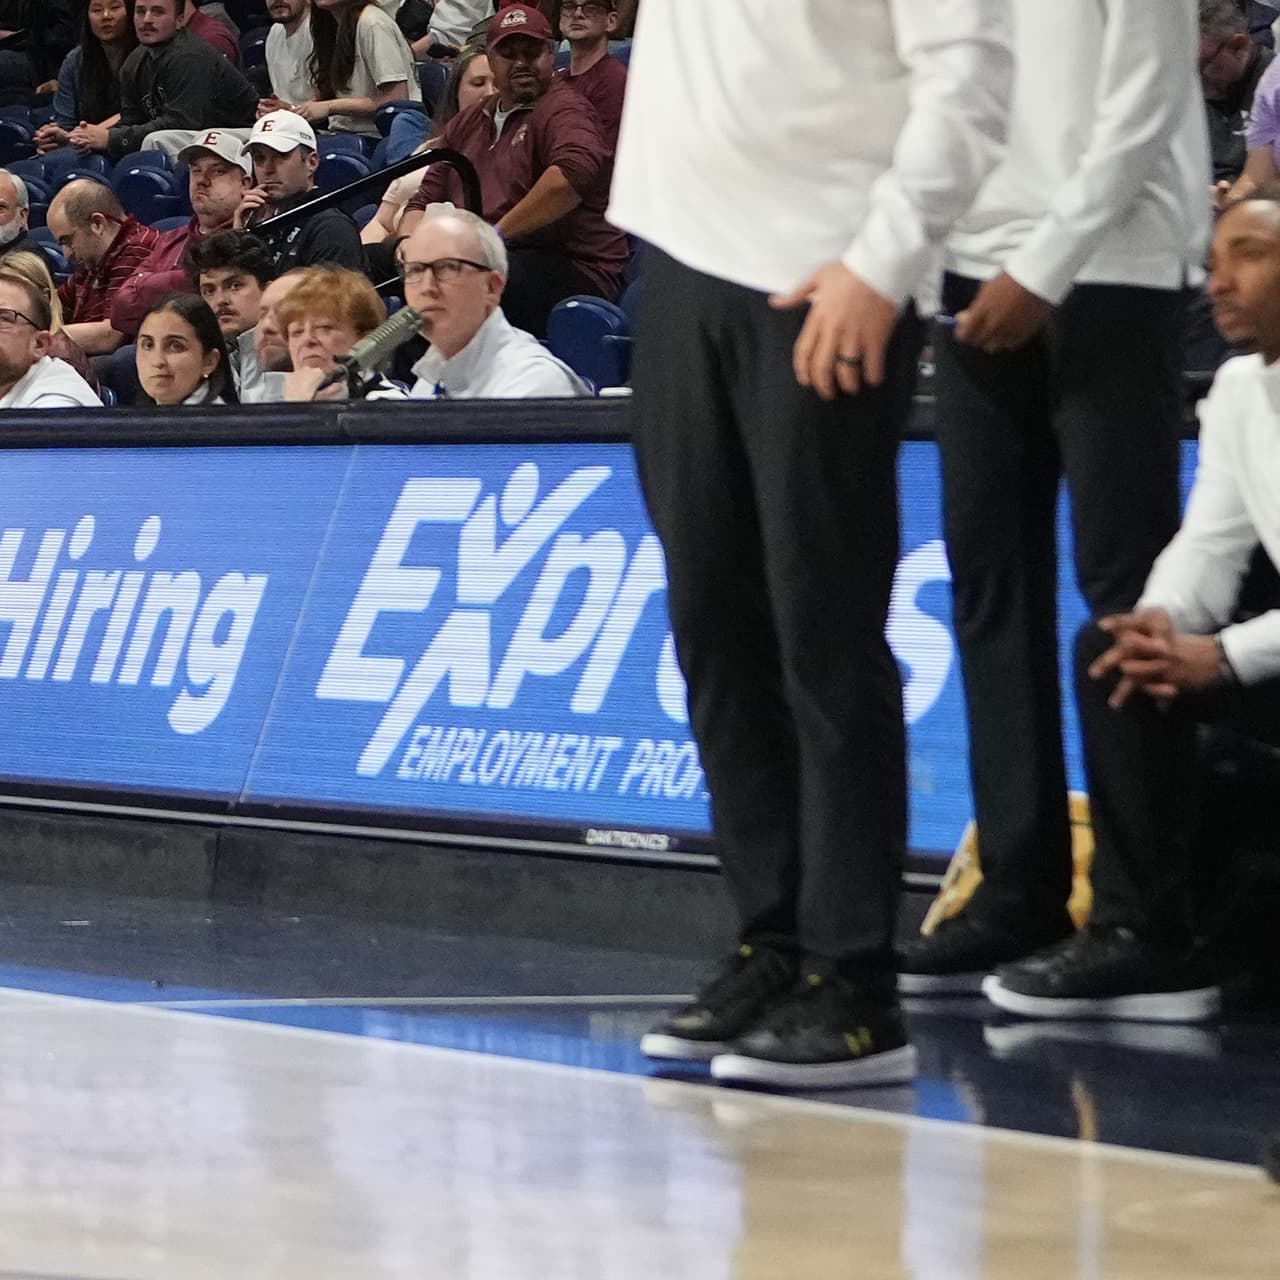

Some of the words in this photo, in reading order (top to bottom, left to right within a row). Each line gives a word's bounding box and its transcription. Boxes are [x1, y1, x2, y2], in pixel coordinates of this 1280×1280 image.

[260, 120, 276, 132] E
[204, 132, 221, 145] E
[395, 725, 623, 793] EMPLOYMENT
